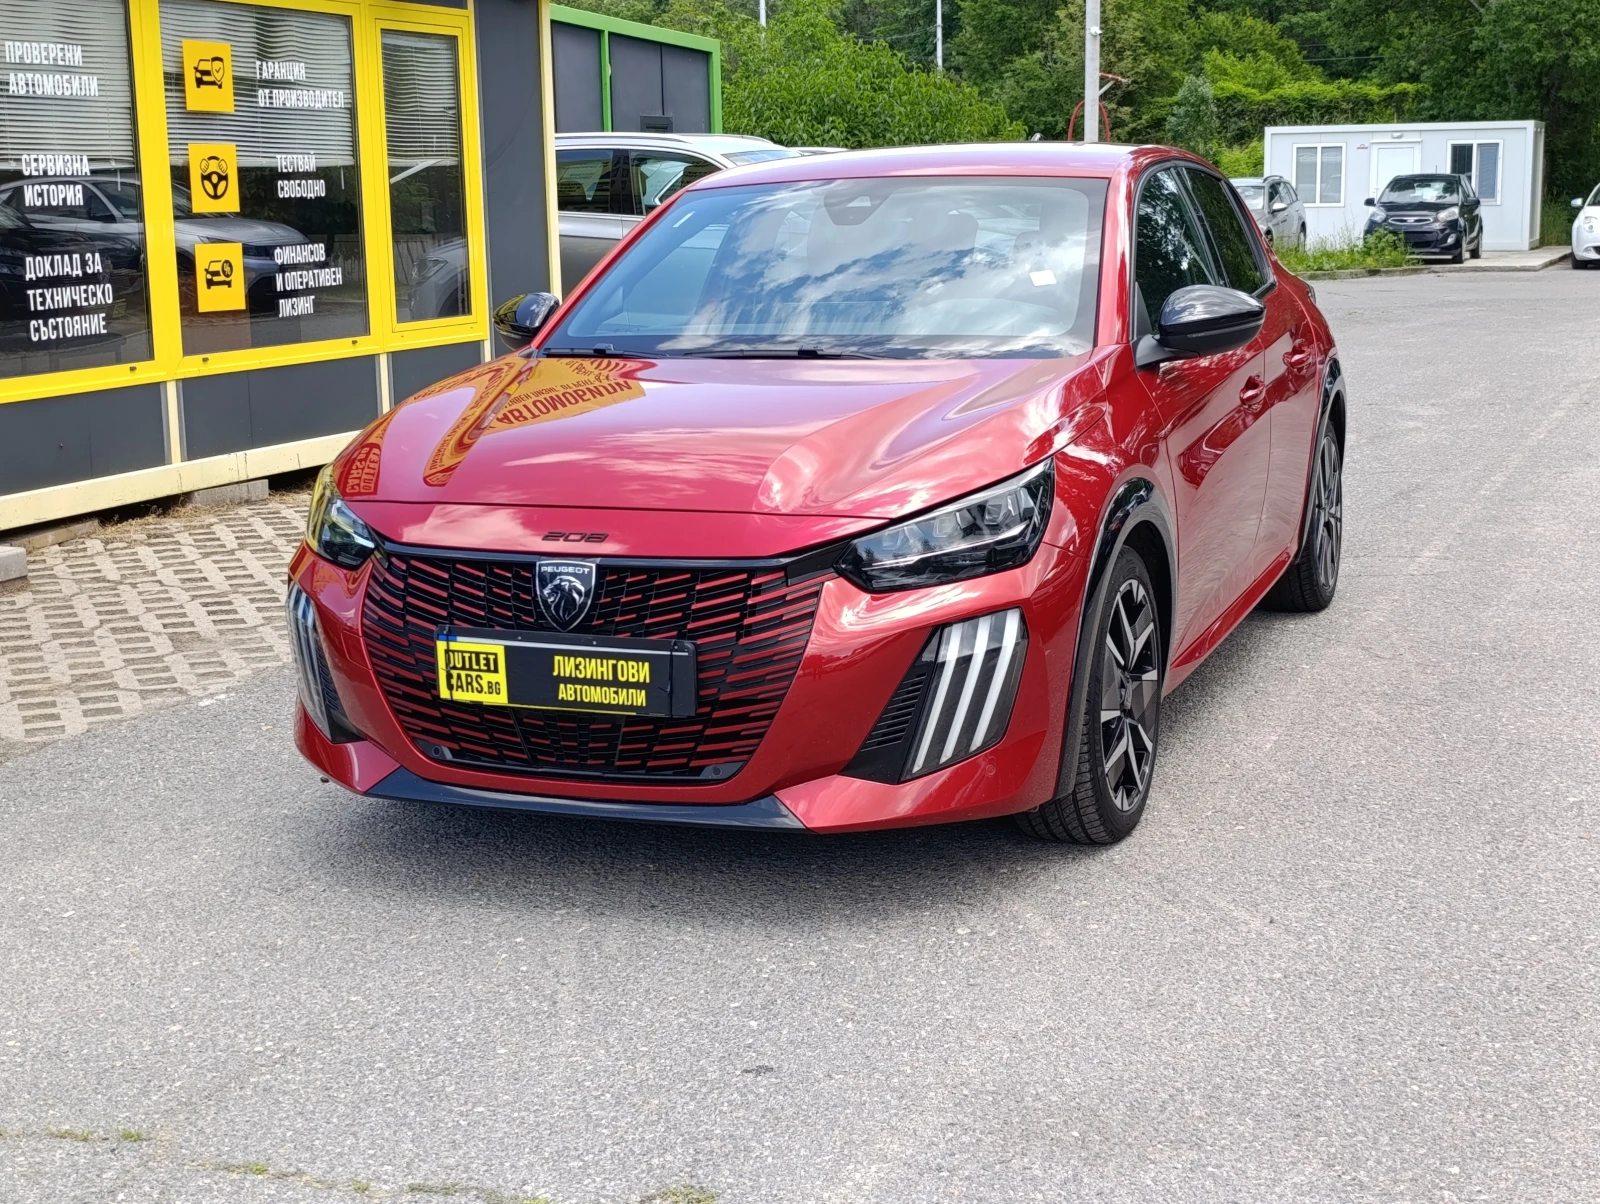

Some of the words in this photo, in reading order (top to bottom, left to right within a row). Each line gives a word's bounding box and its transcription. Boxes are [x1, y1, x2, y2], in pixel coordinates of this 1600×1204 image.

[4, 41, 83, 66] ПРОВЕРЕНИ
[256, 61, 306, 82] ГАРАНЦИЯ
[9, 73, 99, 97] АВТОМОБИЛИ
[258, 89, 270, 107] ОТ
[272, 89, 344, 109] ПРОИЗВОДИТЕЛ
[21, 154, 91, 176] СЕРВИЗНА
[276, 151, 317, 173] ТЕСТВАЙ
[24, 184, 84, 207] ИСТОРИЯ
[277, 179, 326, 200] СВОБОДНО
[274, 243, 326, 265] ФИНАНСОВ
[25, 253, 82, 281] ДОКЛАД
[85, 252, 103, 274] ЗА
[275, 272, 284, 292] И
[284, 267, 343, 291] ОПЕРАТИВЕН
[26, 283, 114, 312] ТЕХНИЧЕСКО
[278, 295, 316, 318] ЛИЗИНГ
[29, 313, 108, 342] СЪСТОЯНИЕ
[541, 531, 609, 543] 208
[541, 566, 590, 574] PEUGEOT
[552, 655, 650, 683] ЛИЗИНГОВИ
[446, 672, 501, 695] CARS.BG
[558, 683, 646, 707] АВТОМОБИЛИ
